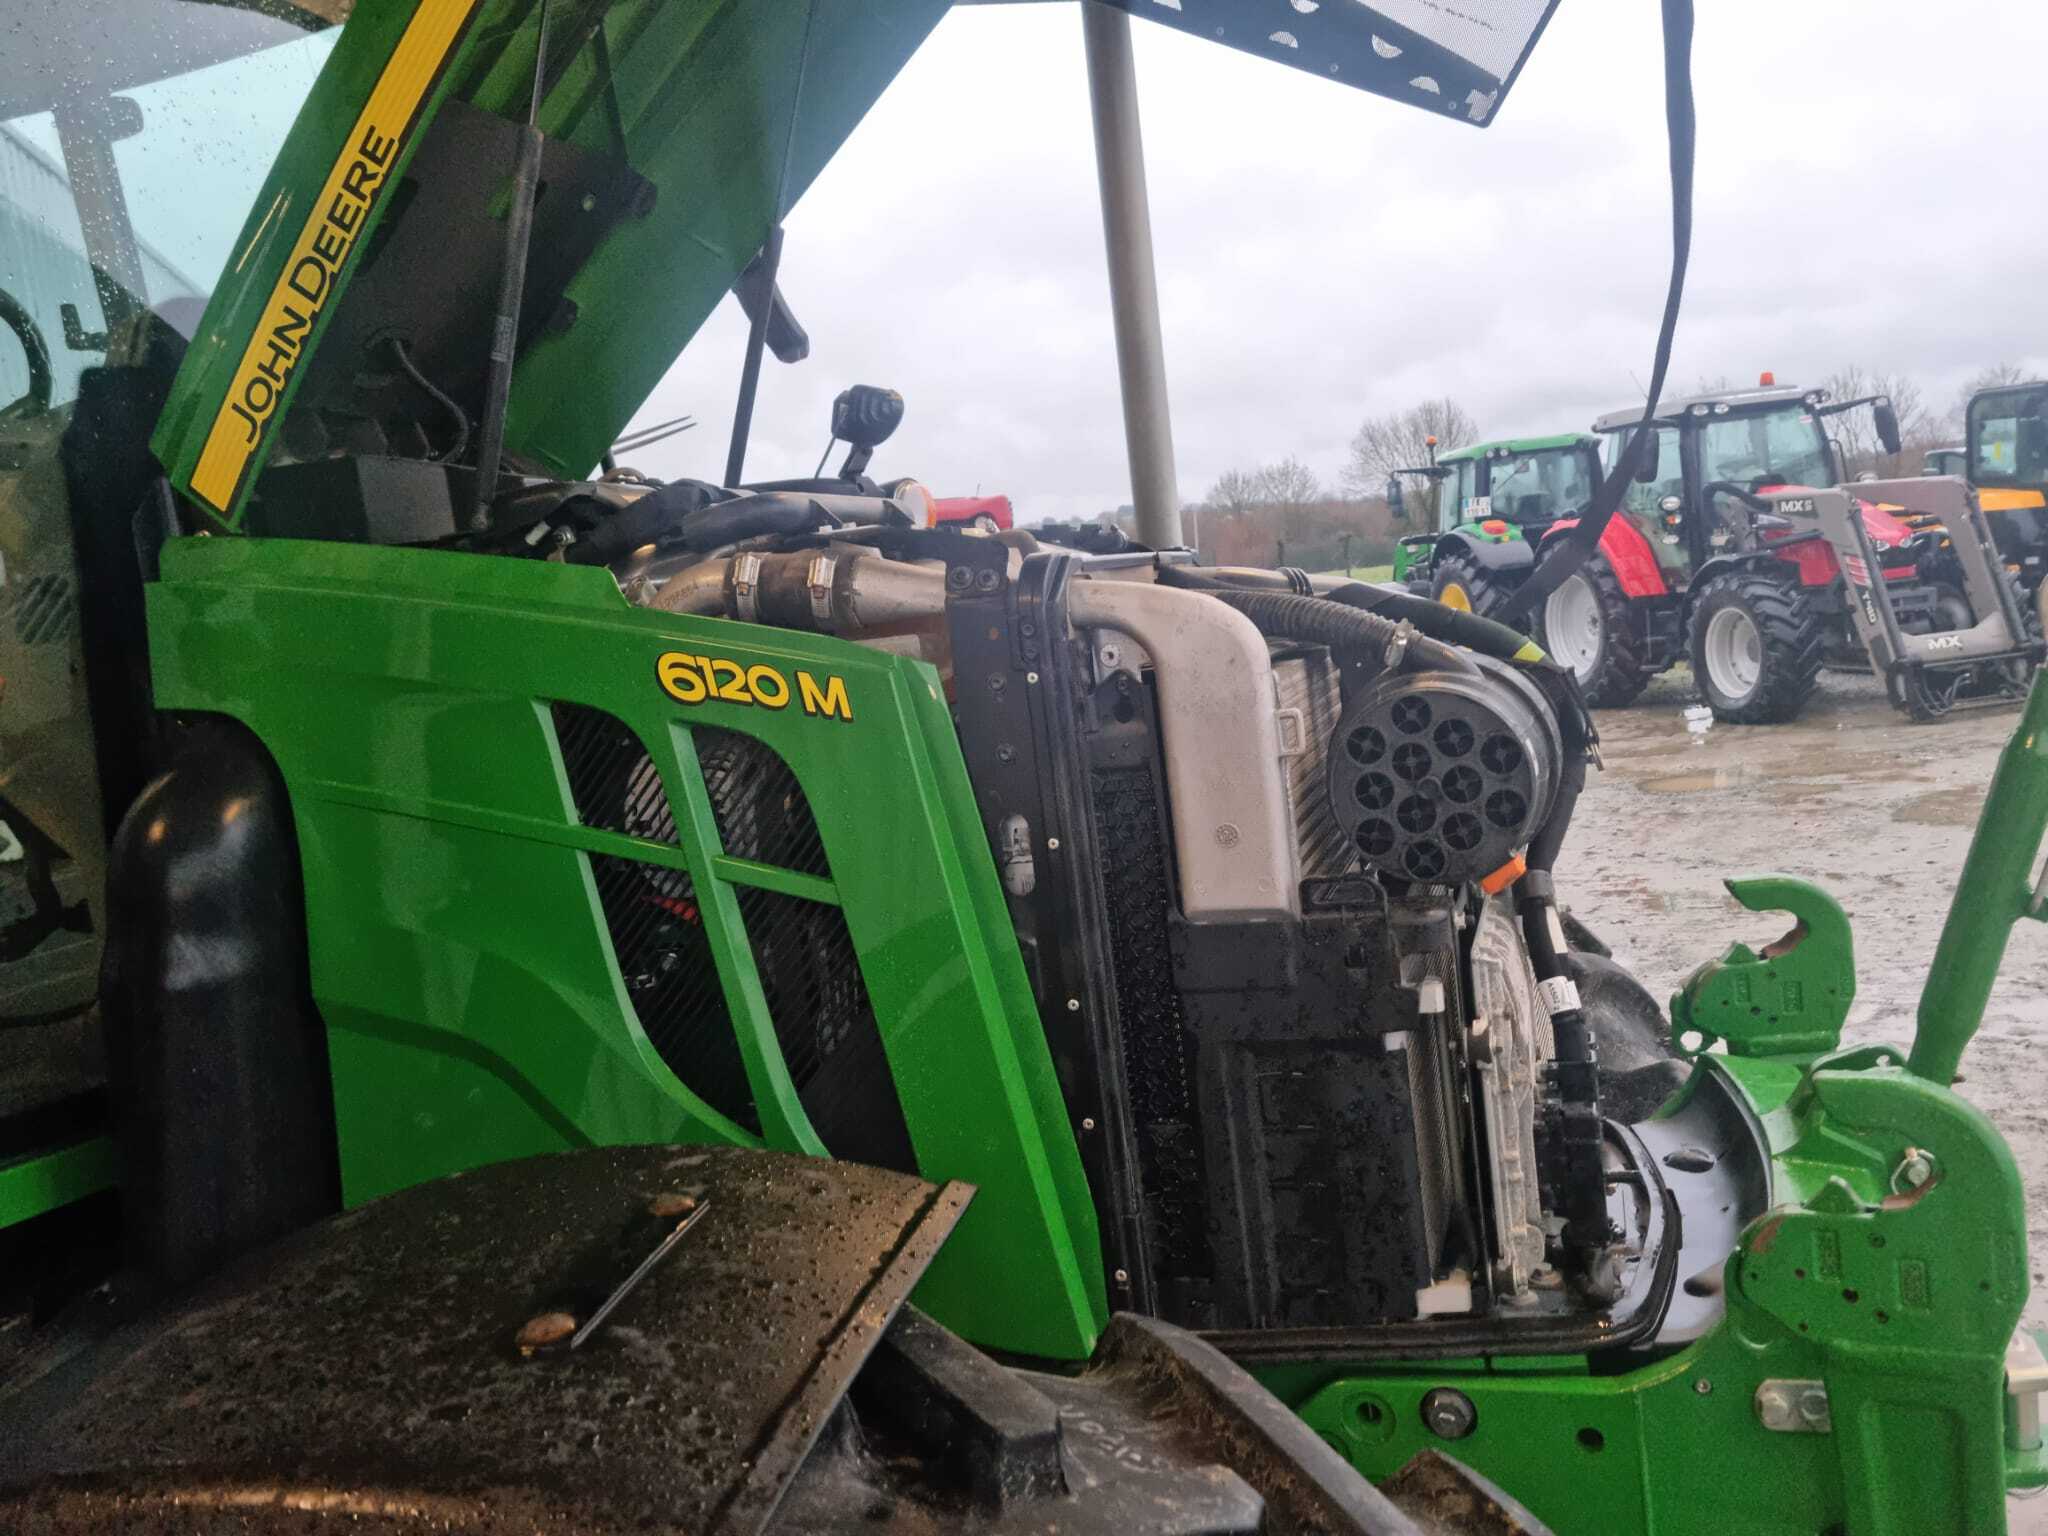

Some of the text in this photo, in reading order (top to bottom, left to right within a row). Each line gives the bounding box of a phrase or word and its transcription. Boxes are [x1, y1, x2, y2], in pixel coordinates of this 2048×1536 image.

[231, 124, 395, 444] JOHN DEERE
[1935, 635, 1963, 649] MX
[656, 651, 854, 722] 6120 M
